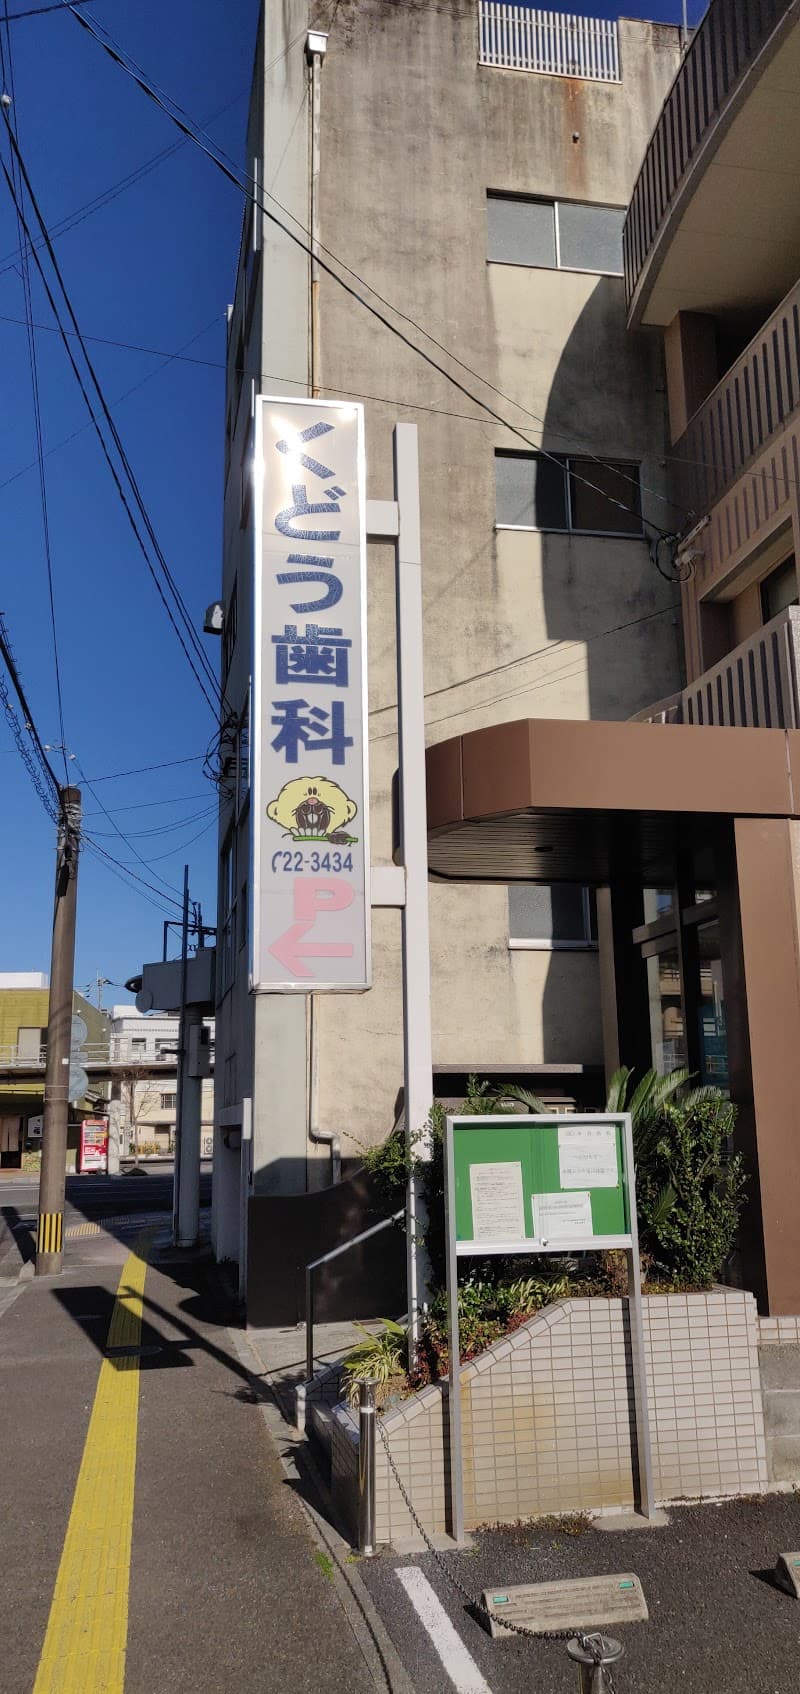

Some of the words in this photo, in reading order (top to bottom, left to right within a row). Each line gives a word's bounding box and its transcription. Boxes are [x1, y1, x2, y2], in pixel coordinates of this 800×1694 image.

[270, 421, 354, 765] くどう歯科
[294, 877, 355, 921] P
